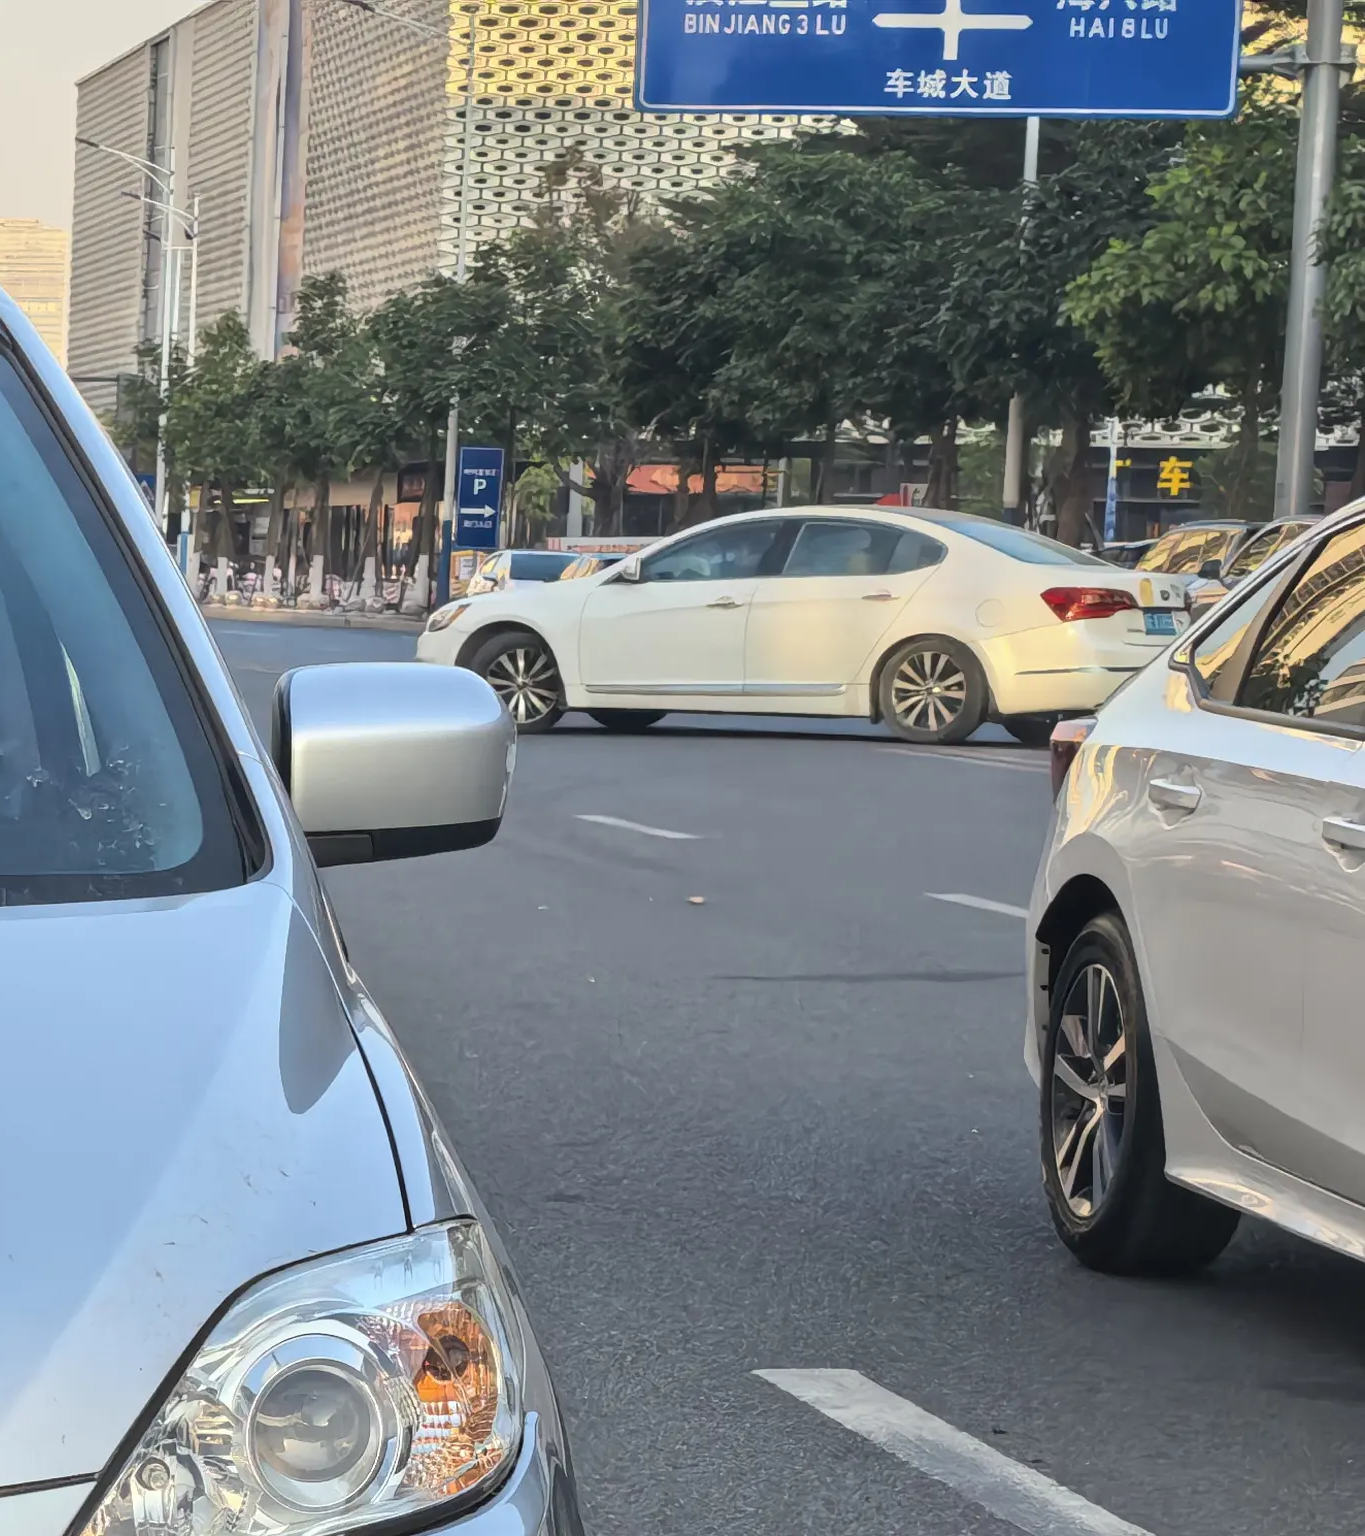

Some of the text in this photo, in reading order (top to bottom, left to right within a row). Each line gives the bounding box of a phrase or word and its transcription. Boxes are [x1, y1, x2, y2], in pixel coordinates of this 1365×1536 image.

[684, 14, 847, 35] BINJIANG 3 LU
[1069, 17, 1115, 38] HAI
[1140, 18, 1169, 39] LU
[883, 68, 1013, 100] 车城大道
[473, 478, 487, 495] P
